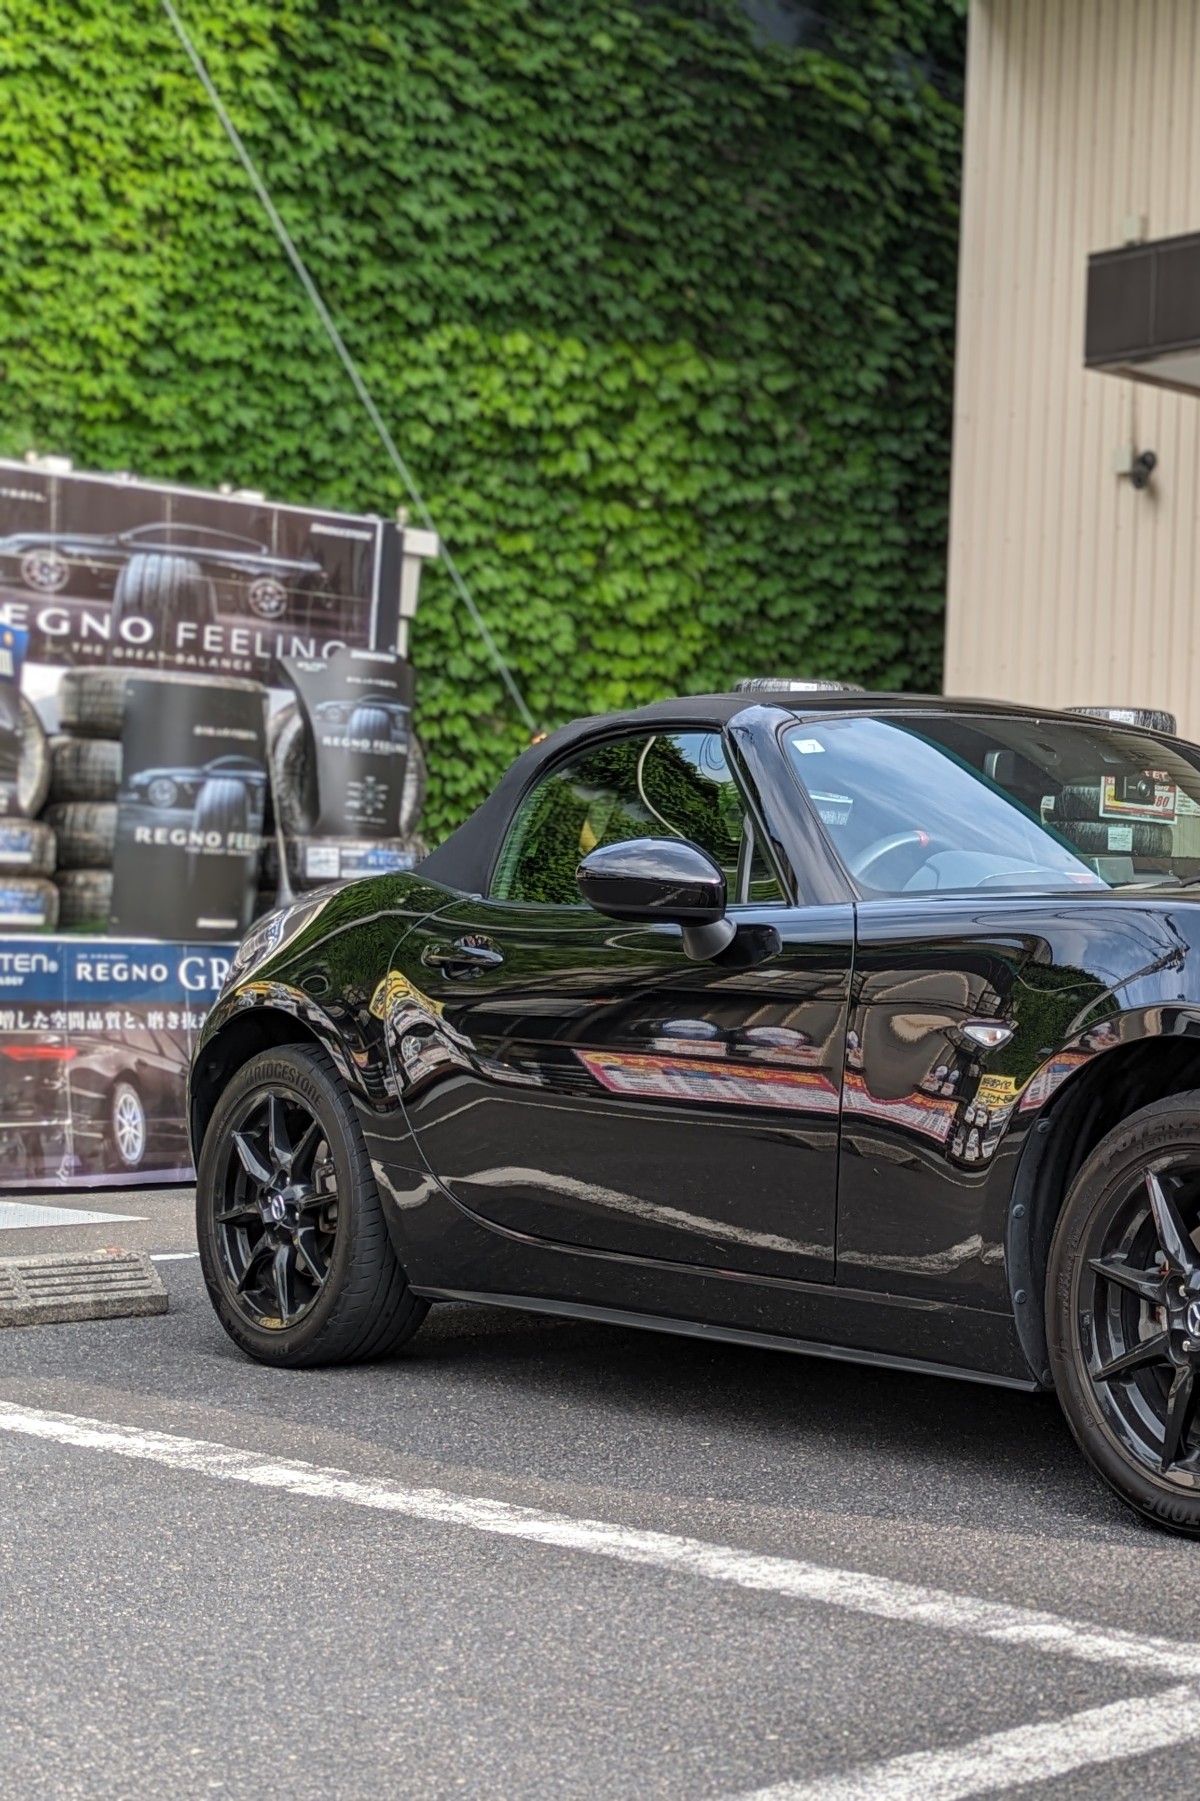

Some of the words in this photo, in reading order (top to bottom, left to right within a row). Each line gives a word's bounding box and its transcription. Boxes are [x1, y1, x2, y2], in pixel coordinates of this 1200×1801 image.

[134, 826, 222, 848] REGNO
[76, 963, 169, 982] REGNO
[244, 1062, 324, 1107] BRIDGESTONE
